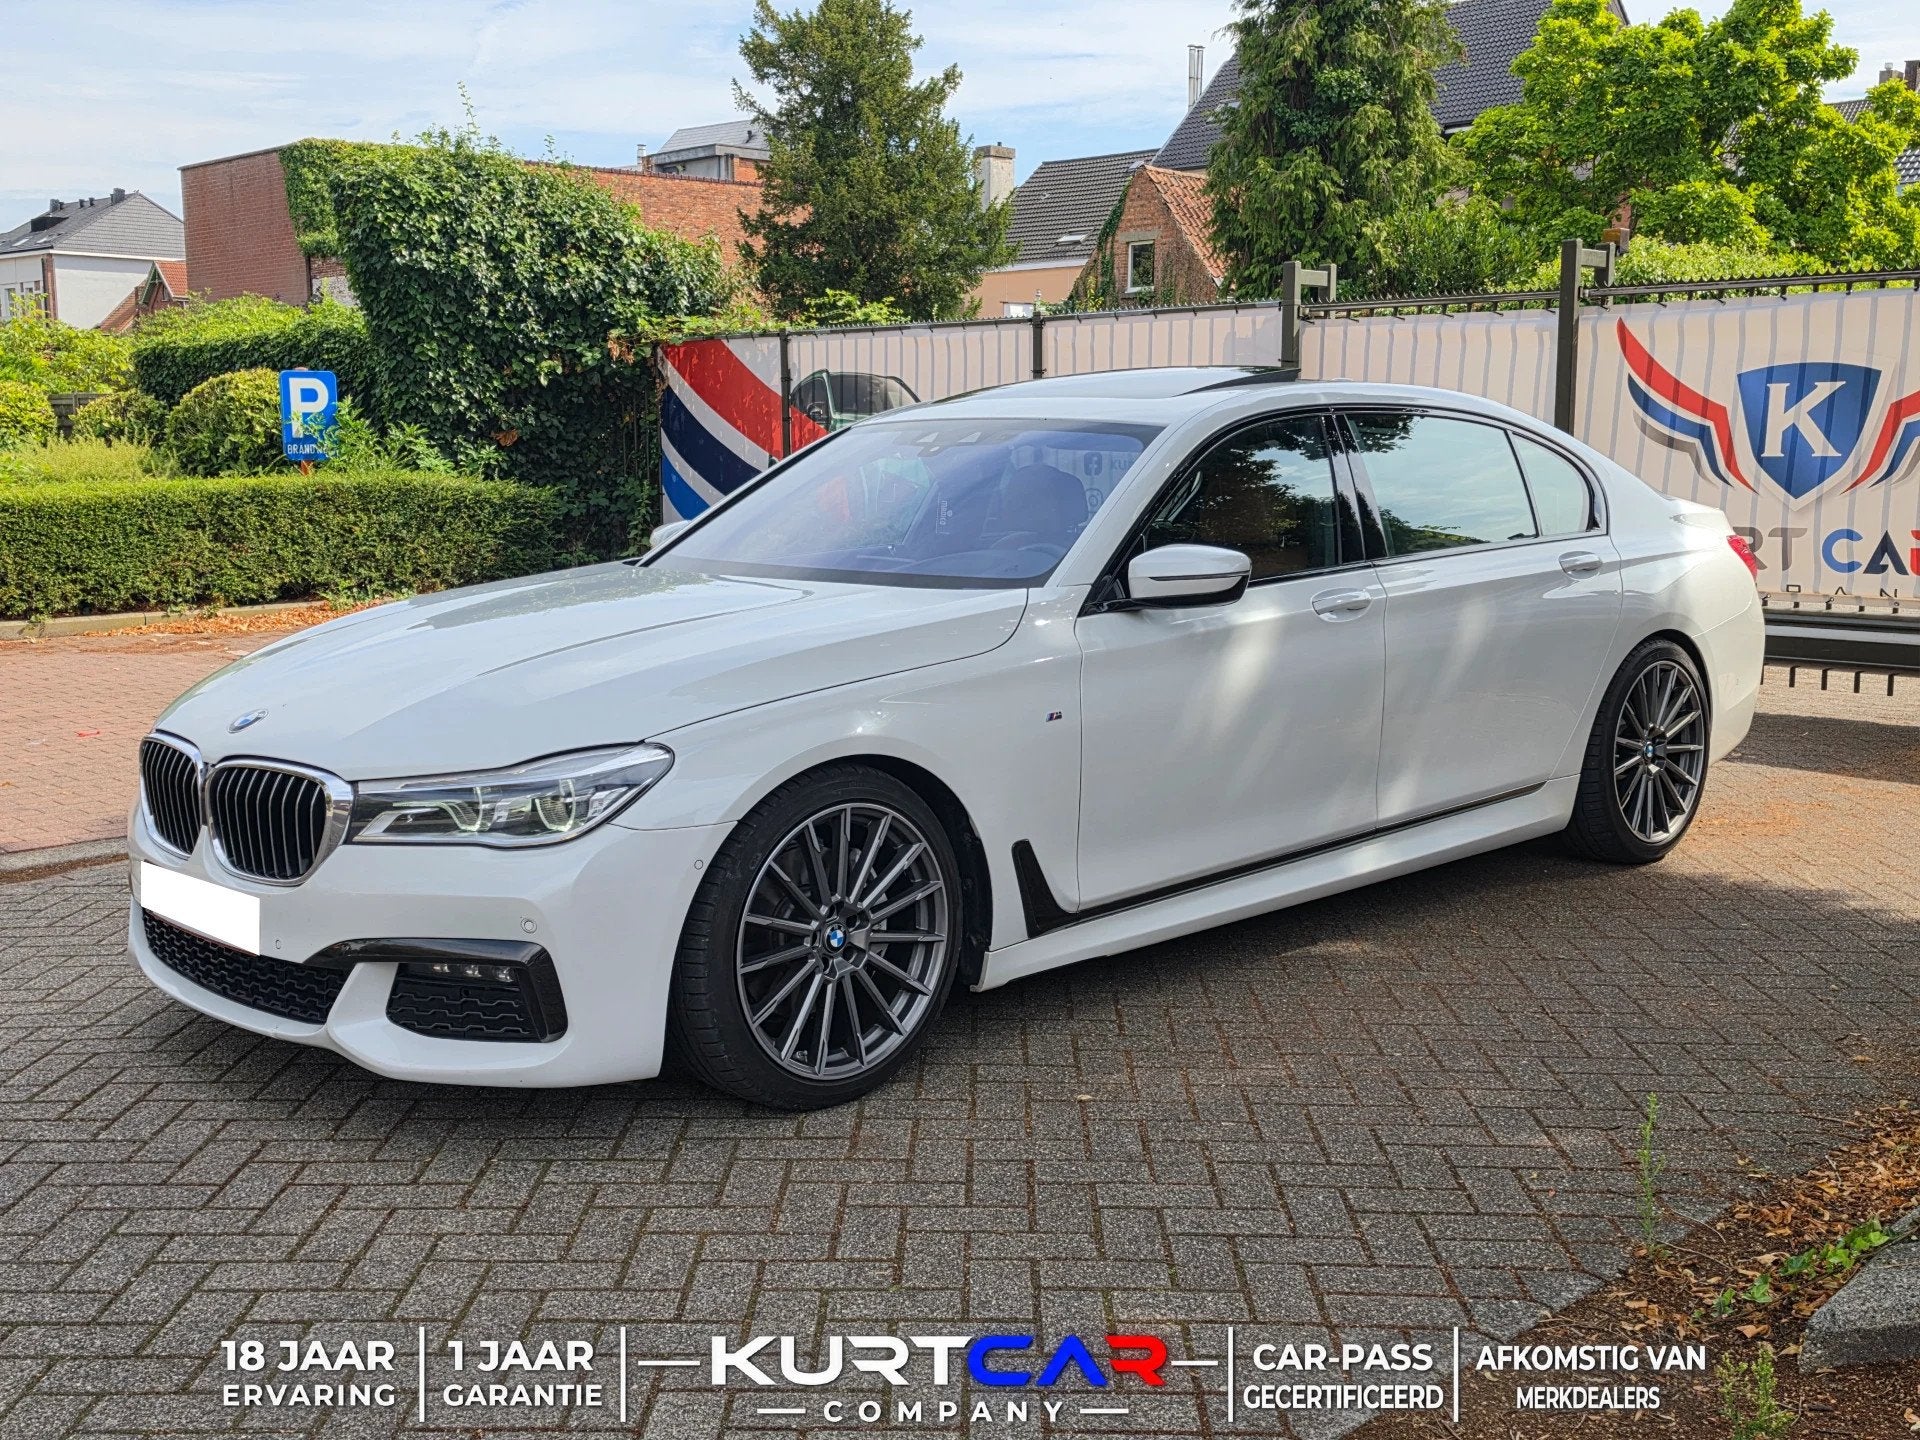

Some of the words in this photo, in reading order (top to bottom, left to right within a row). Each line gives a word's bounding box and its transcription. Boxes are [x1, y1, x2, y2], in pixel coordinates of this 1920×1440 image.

[288, 377, 329, 438] P
[1760, 380, 1847, 457] K
[1732, 526, 1808, 571] RT
